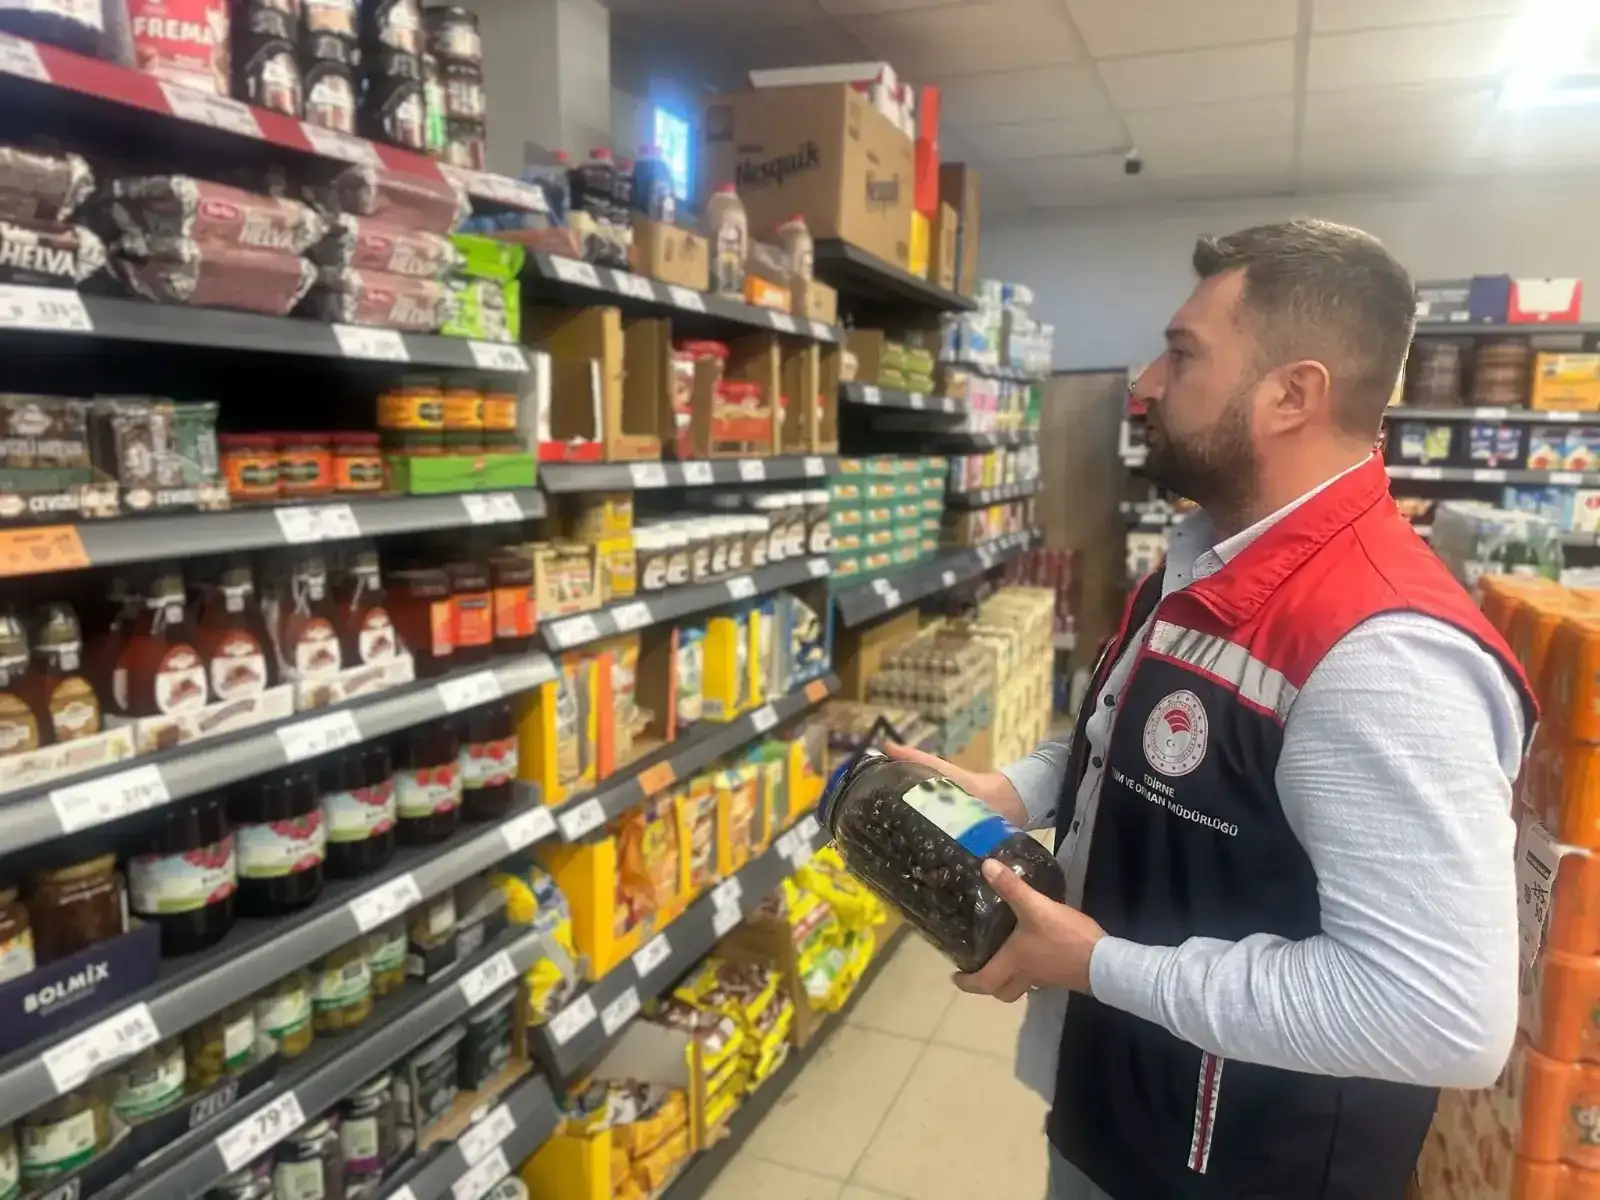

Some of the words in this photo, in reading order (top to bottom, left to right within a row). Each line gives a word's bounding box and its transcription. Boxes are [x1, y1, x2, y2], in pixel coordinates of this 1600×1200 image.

[1144, 773, 1175, 798] EDİRNE
[1125, 776, 1135, 790] VE
[1167, 800, 1239, 837] MÜDÜRLÜĞÜ
[24, 961, 109, 1014] BOLMİX
[254, 1106, 280, 1135] 79
